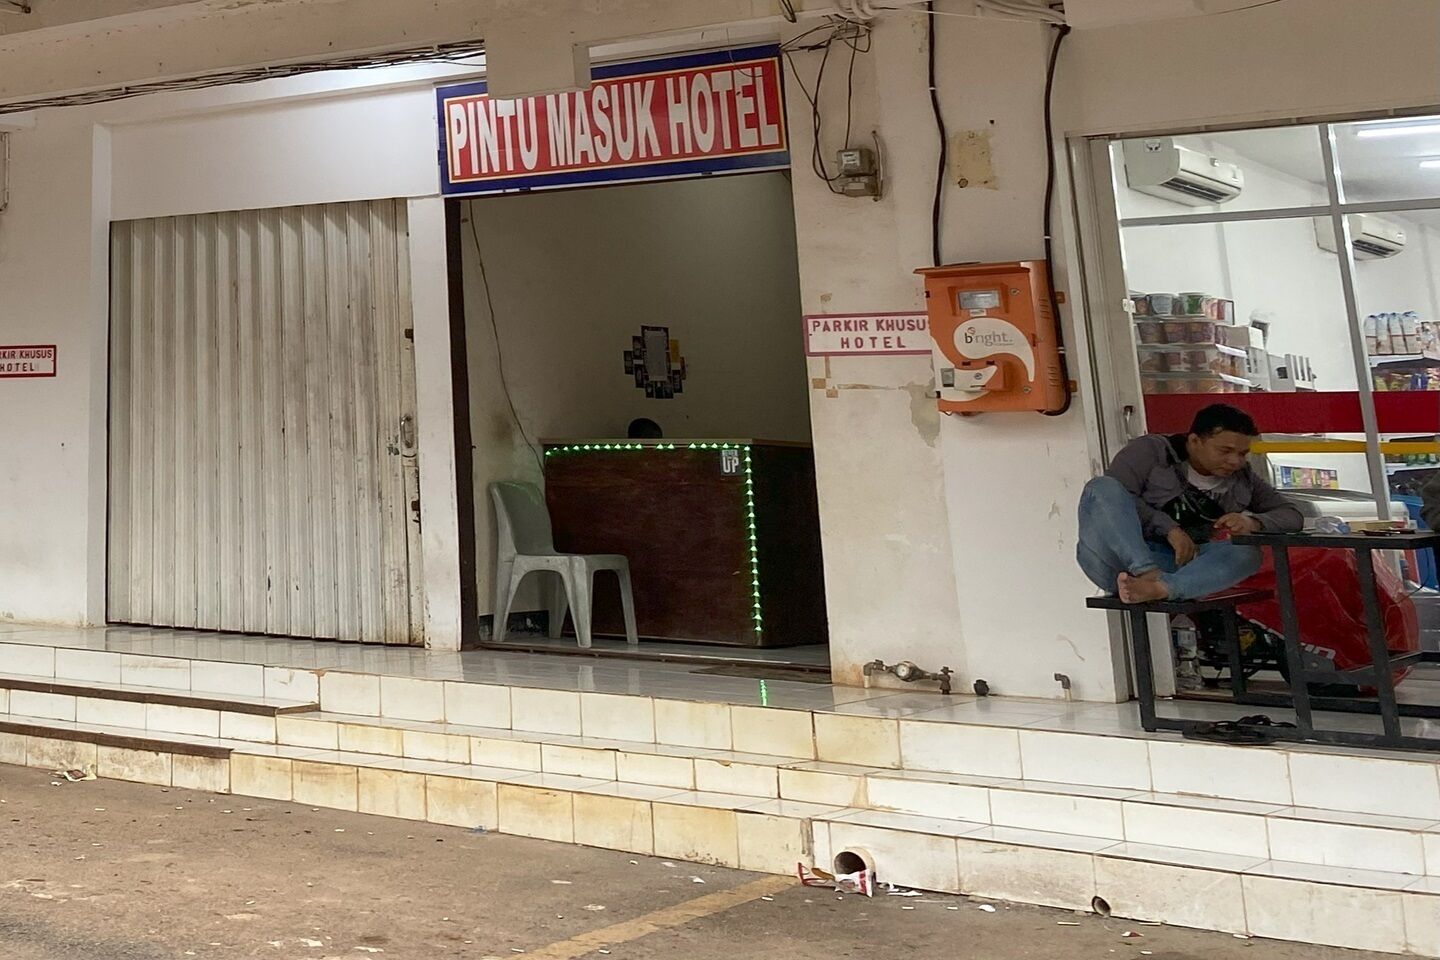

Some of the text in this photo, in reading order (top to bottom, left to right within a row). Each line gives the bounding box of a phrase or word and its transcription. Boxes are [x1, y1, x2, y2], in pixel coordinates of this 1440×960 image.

[449, 66, 780, 176] PINTU MASUK HOTEL
[812, 318, 930, 332] PARKIR KHUSU
[840, 335, 907, 349] HOTEL
[19, 349, 52, 359] KHUSUS
[0, 362, 35, 372] HOTEL
